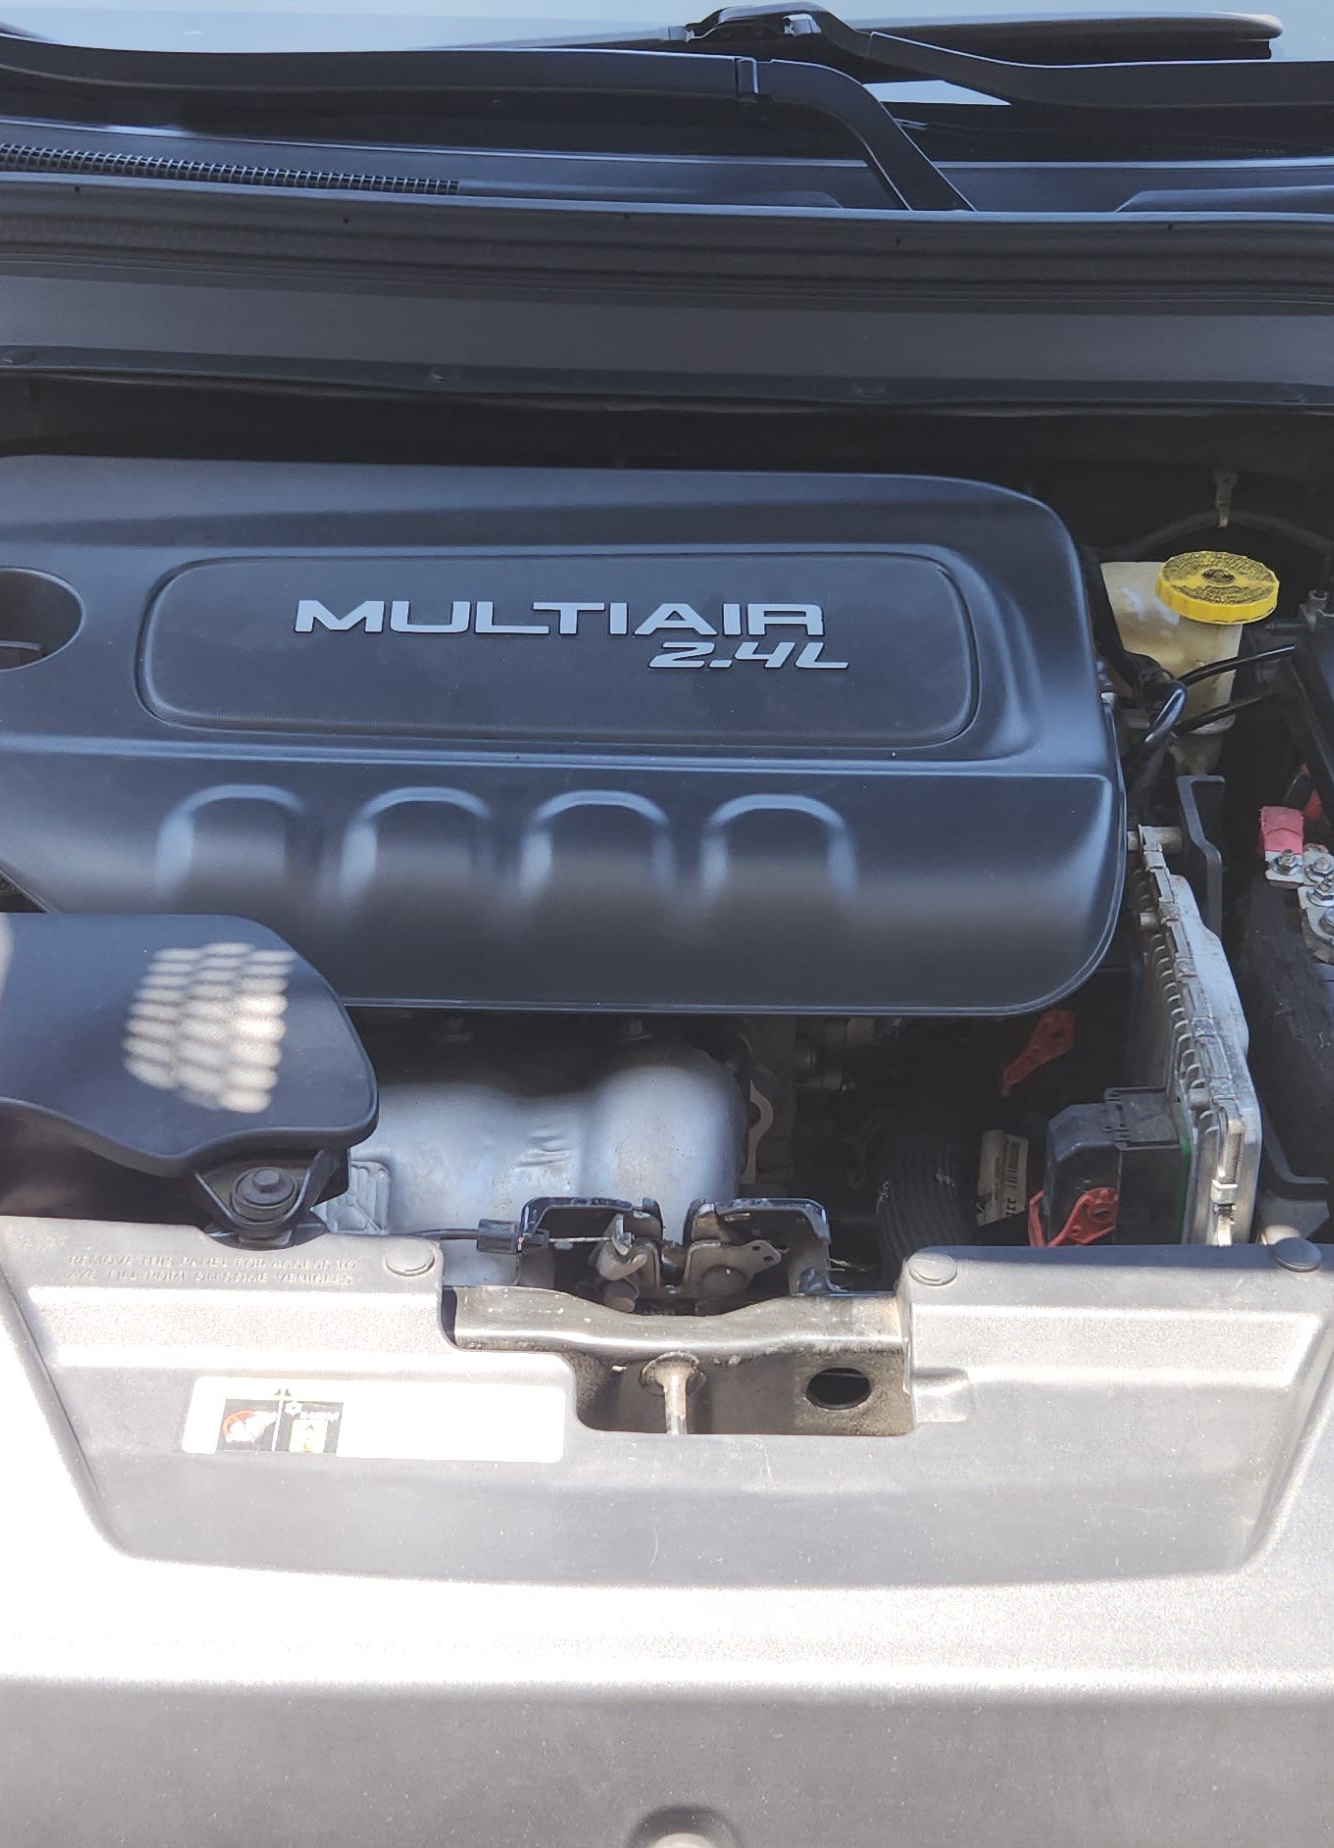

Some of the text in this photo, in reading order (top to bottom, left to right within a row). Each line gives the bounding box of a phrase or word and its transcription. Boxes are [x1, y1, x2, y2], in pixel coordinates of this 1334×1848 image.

[293, 599, 825, 638] MULTIAIR
[648, 640, 849, 670] 2.4L
[68, 1254, 134, 1266] REMOVE
[141, 1255, 175, 1267] THIS
[234, 1257, 267, 1268] FOR
